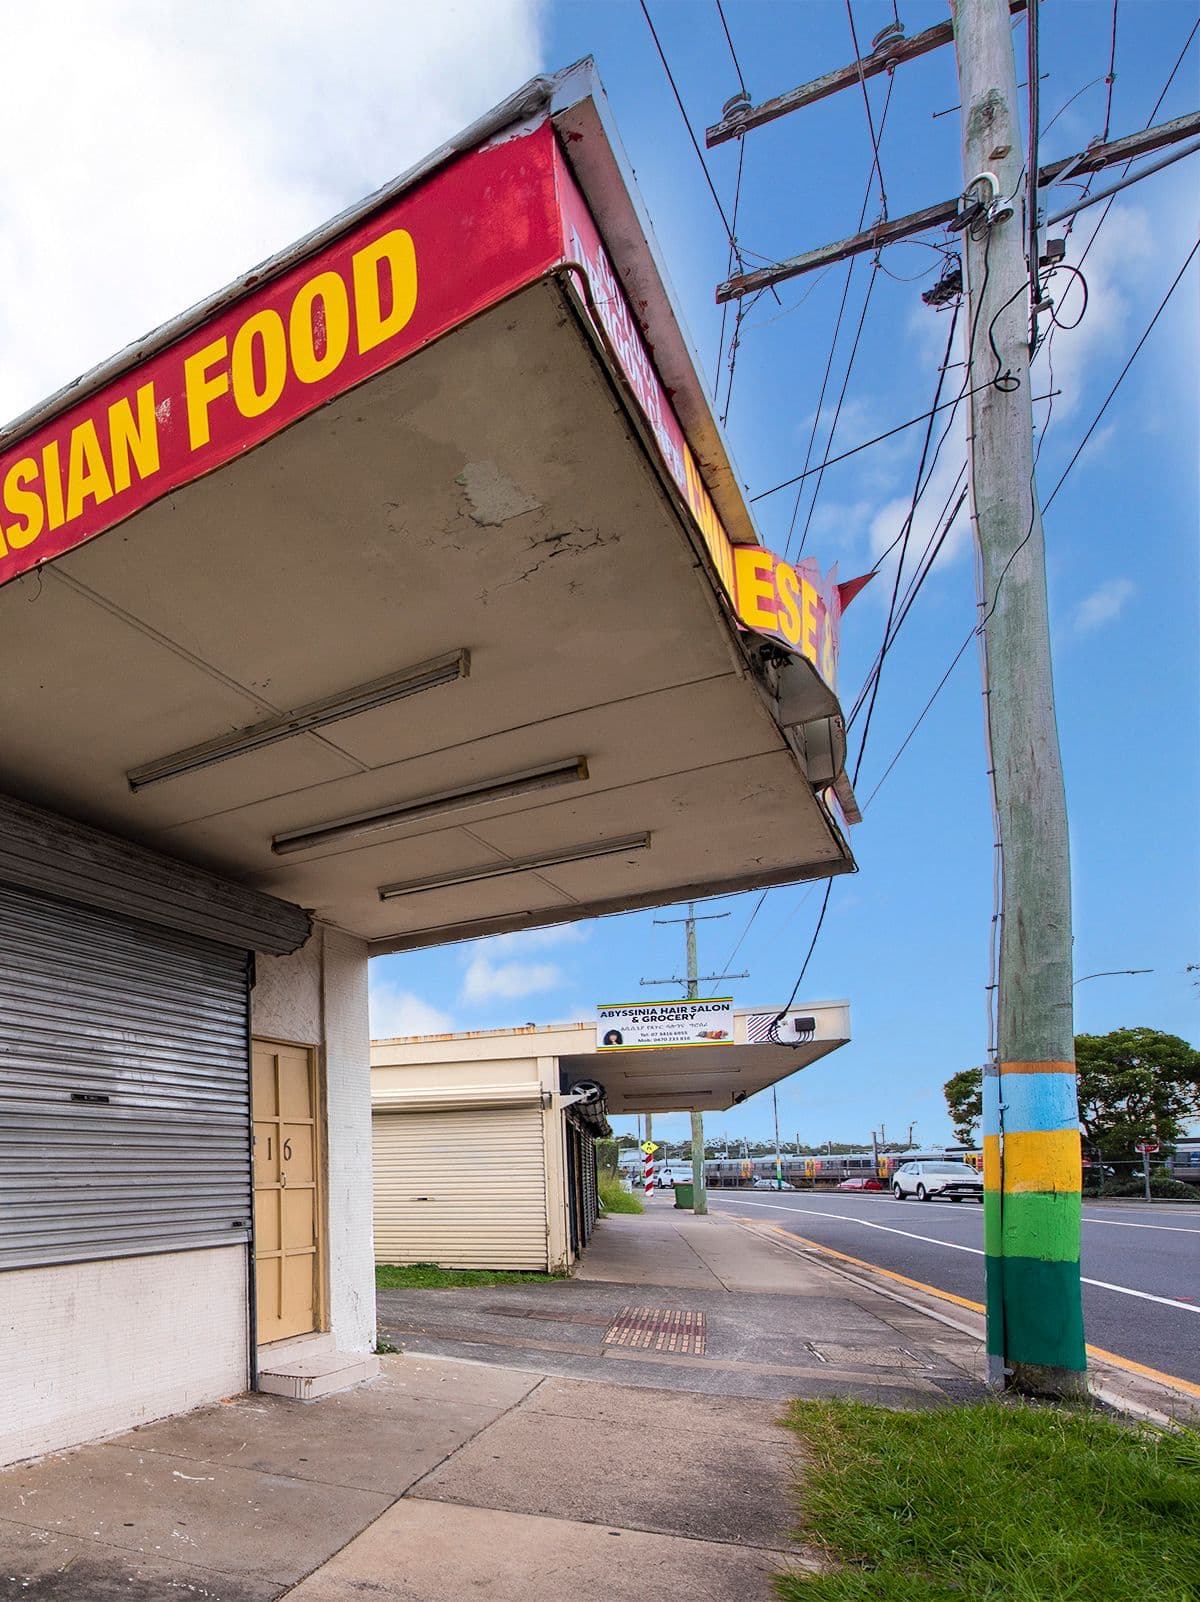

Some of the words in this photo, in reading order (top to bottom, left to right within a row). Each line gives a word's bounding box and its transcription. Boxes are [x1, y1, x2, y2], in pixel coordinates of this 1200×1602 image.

[185, 228, 418, 451] FOOD
[600, 1008, 656, 1018] ABYSSINIA
[660, 1005, 688, 1014] HAIR
[690, 1004, 730, 1013] SALON
[642, 1013, 696, 1022] GROCERY
[267, 1137, 292, 1161] 16
